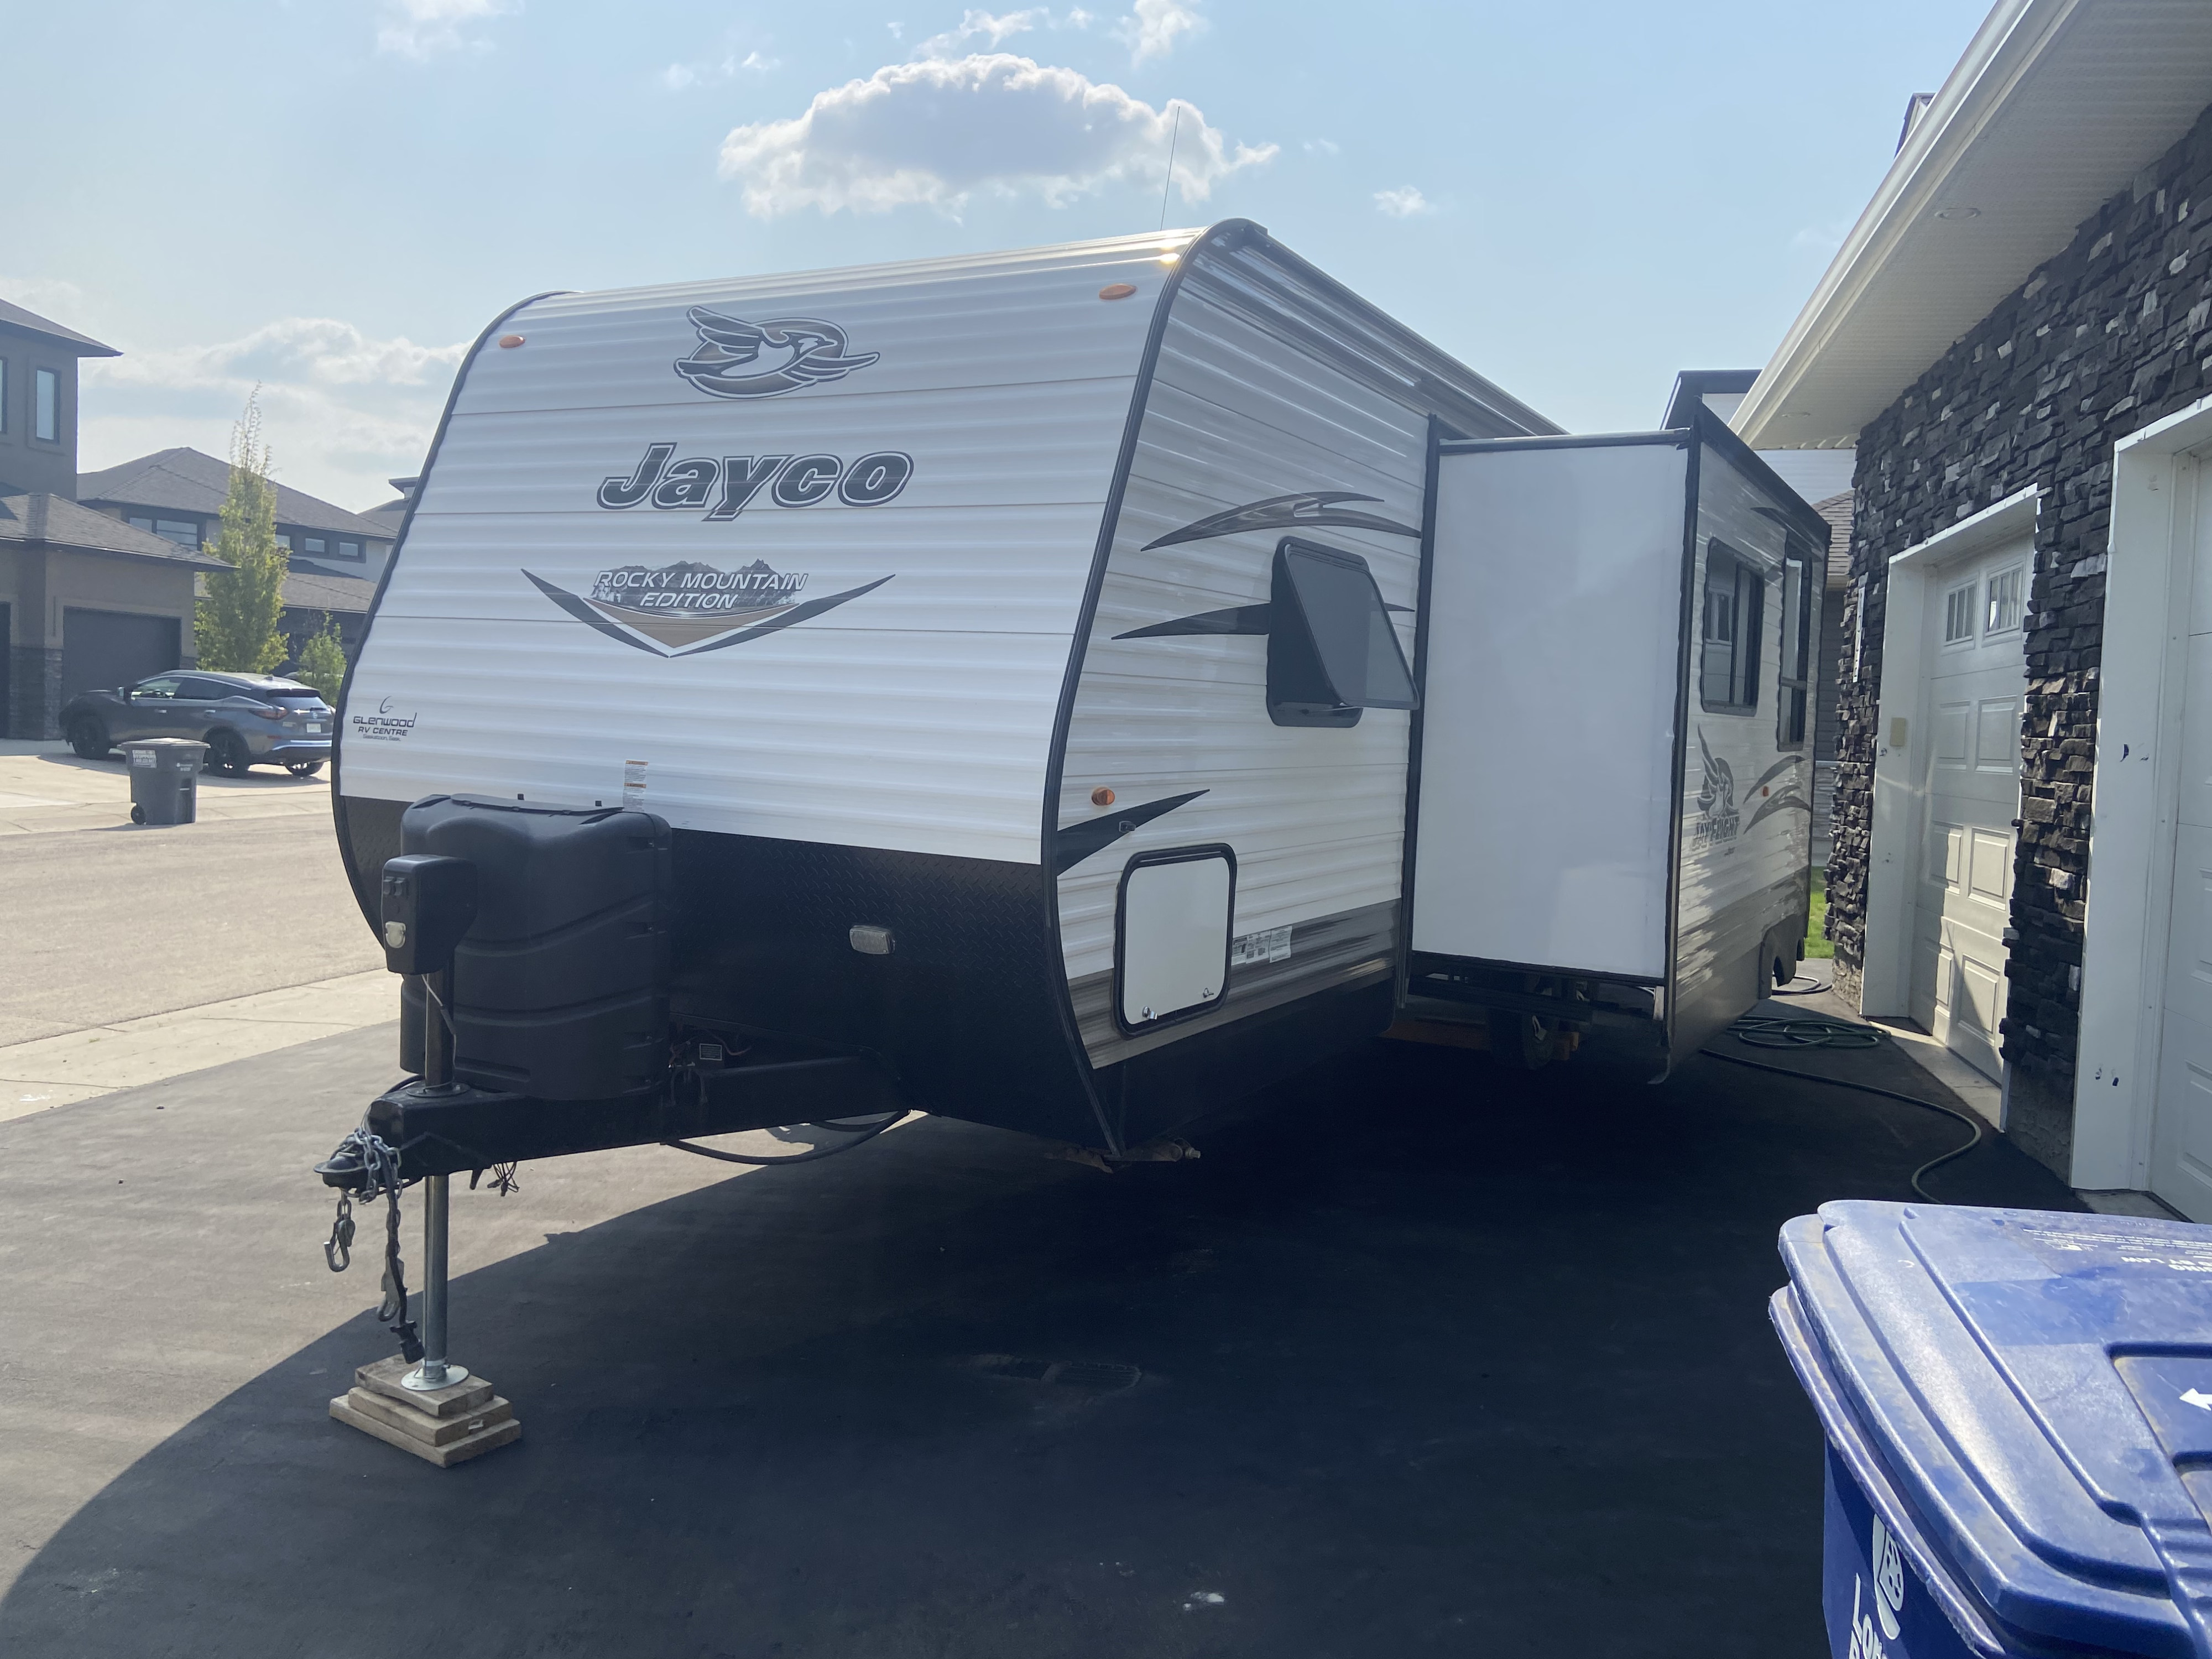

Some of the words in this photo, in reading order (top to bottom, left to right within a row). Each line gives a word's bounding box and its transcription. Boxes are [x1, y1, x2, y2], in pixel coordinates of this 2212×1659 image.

[597, 442, 914, 521] Jayco
[593, 571, 679, 589] ROCKY
[680, 572, 808, 591] MOUNTAIN
[640, 592, 738, 609] EDITION
[373, 727, 408, 736] CENTRE
